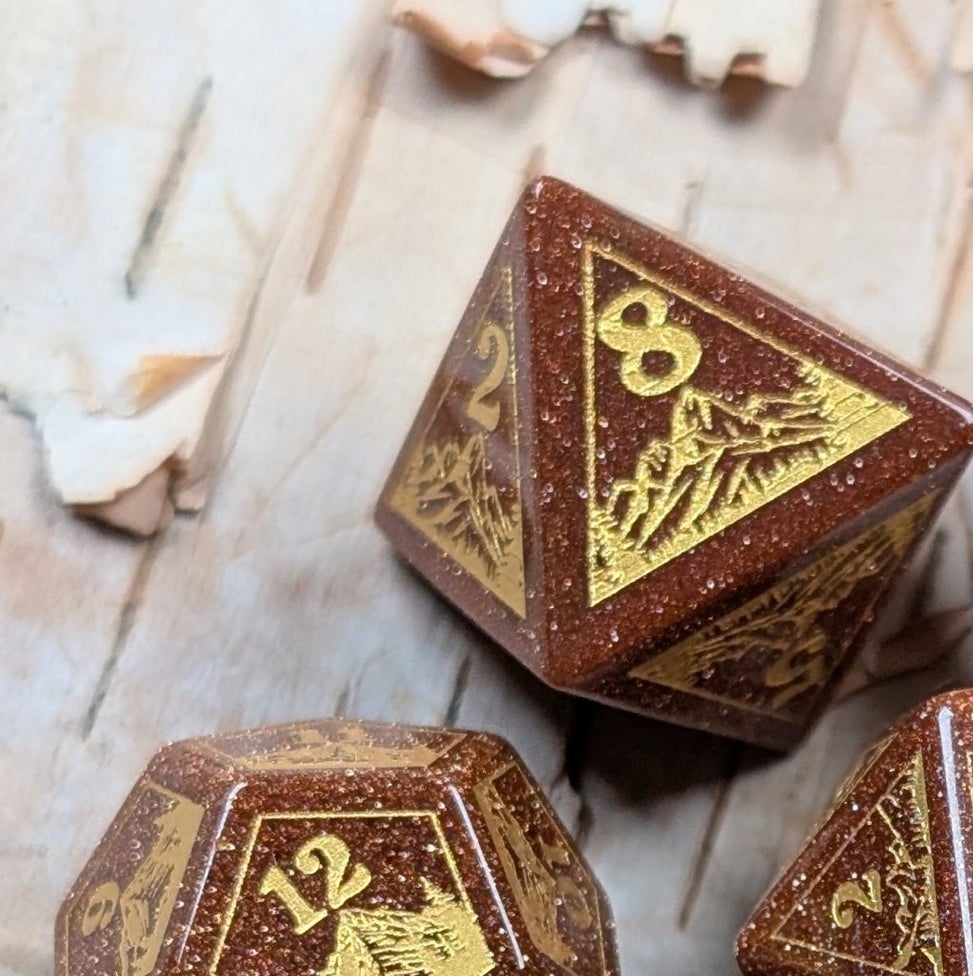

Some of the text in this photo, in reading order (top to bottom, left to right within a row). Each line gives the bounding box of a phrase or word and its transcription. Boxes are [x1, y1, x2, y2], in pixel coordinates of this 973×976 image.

[467, 321, 505, 433] 2
[599, 287, 703, 396] 8
[259, 833, 371, 935] 12
[832, 869, 882, 929] 2
